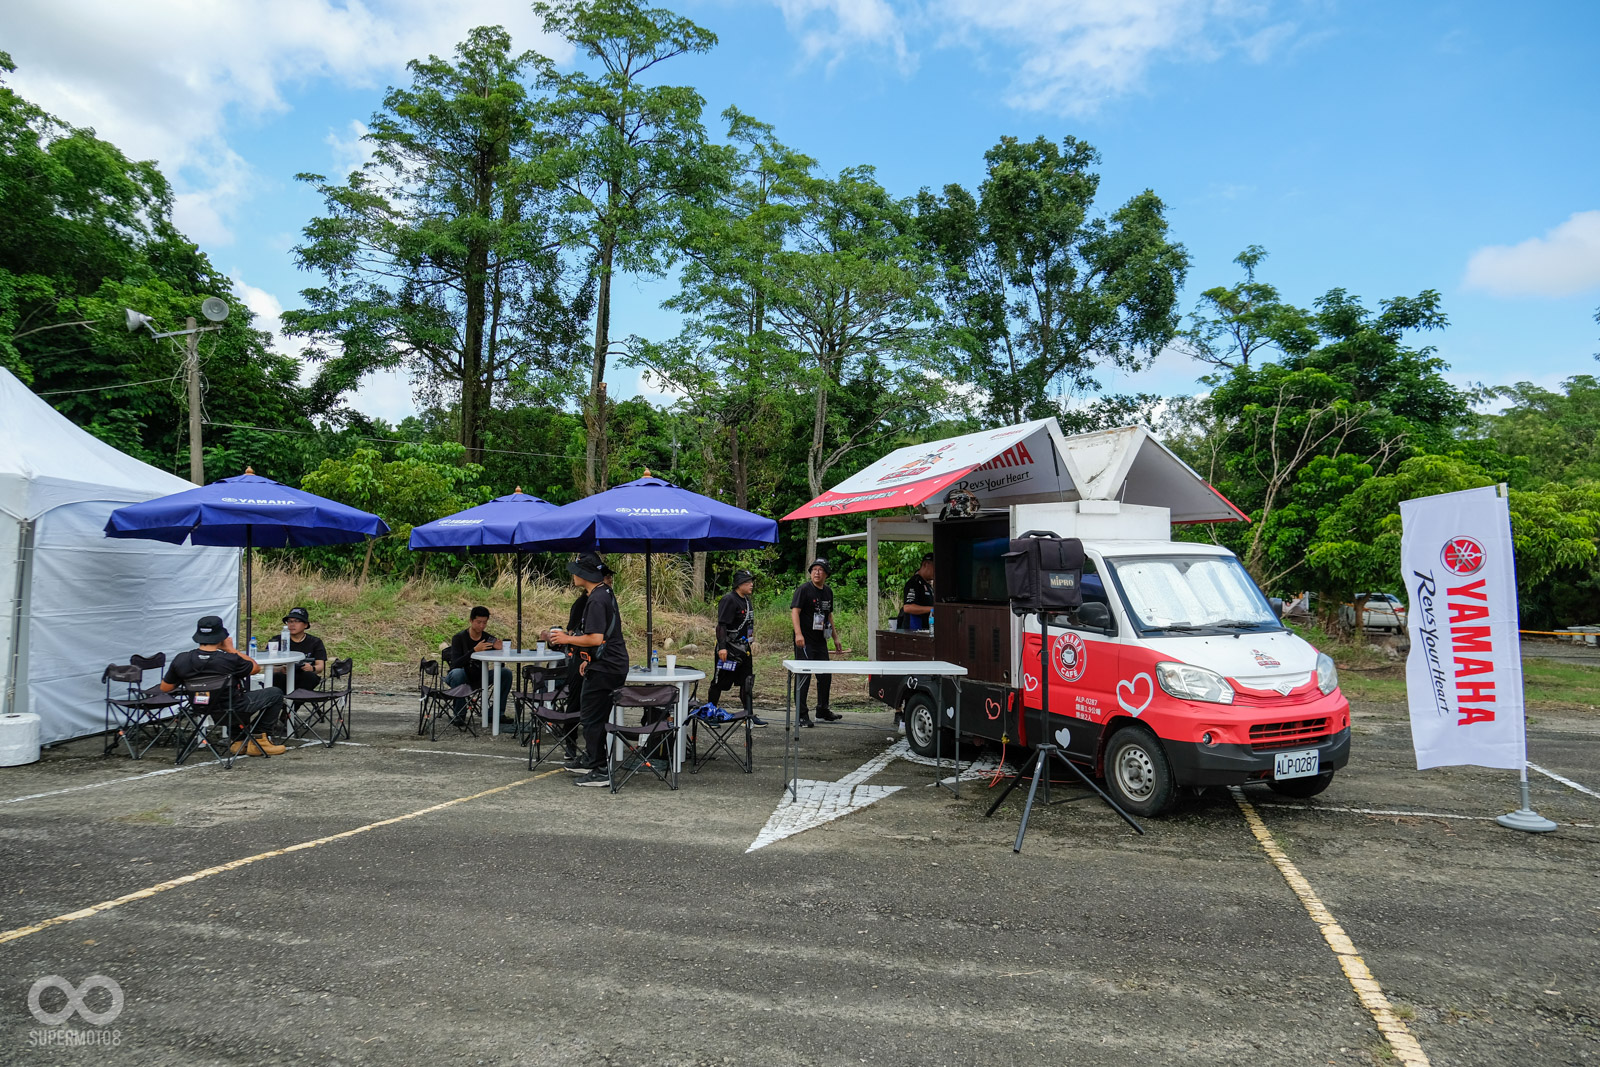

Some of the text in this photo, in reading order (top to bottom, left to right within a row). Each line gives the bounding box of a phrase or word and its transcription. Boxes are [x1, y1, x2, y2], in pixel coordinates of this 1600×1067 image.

[955, 471, 1029, 492] Revs Your Heart
[1056, 634, 1083, 653] YAMAHA
[1413, 569, 1450, 715] Revs Your Heart
[1446, 578, 1496, 727] YAMAHA
[1075, 695, 1098, 706] ALP-0287
[1276, 755, 1318, 776] ALP-0287
